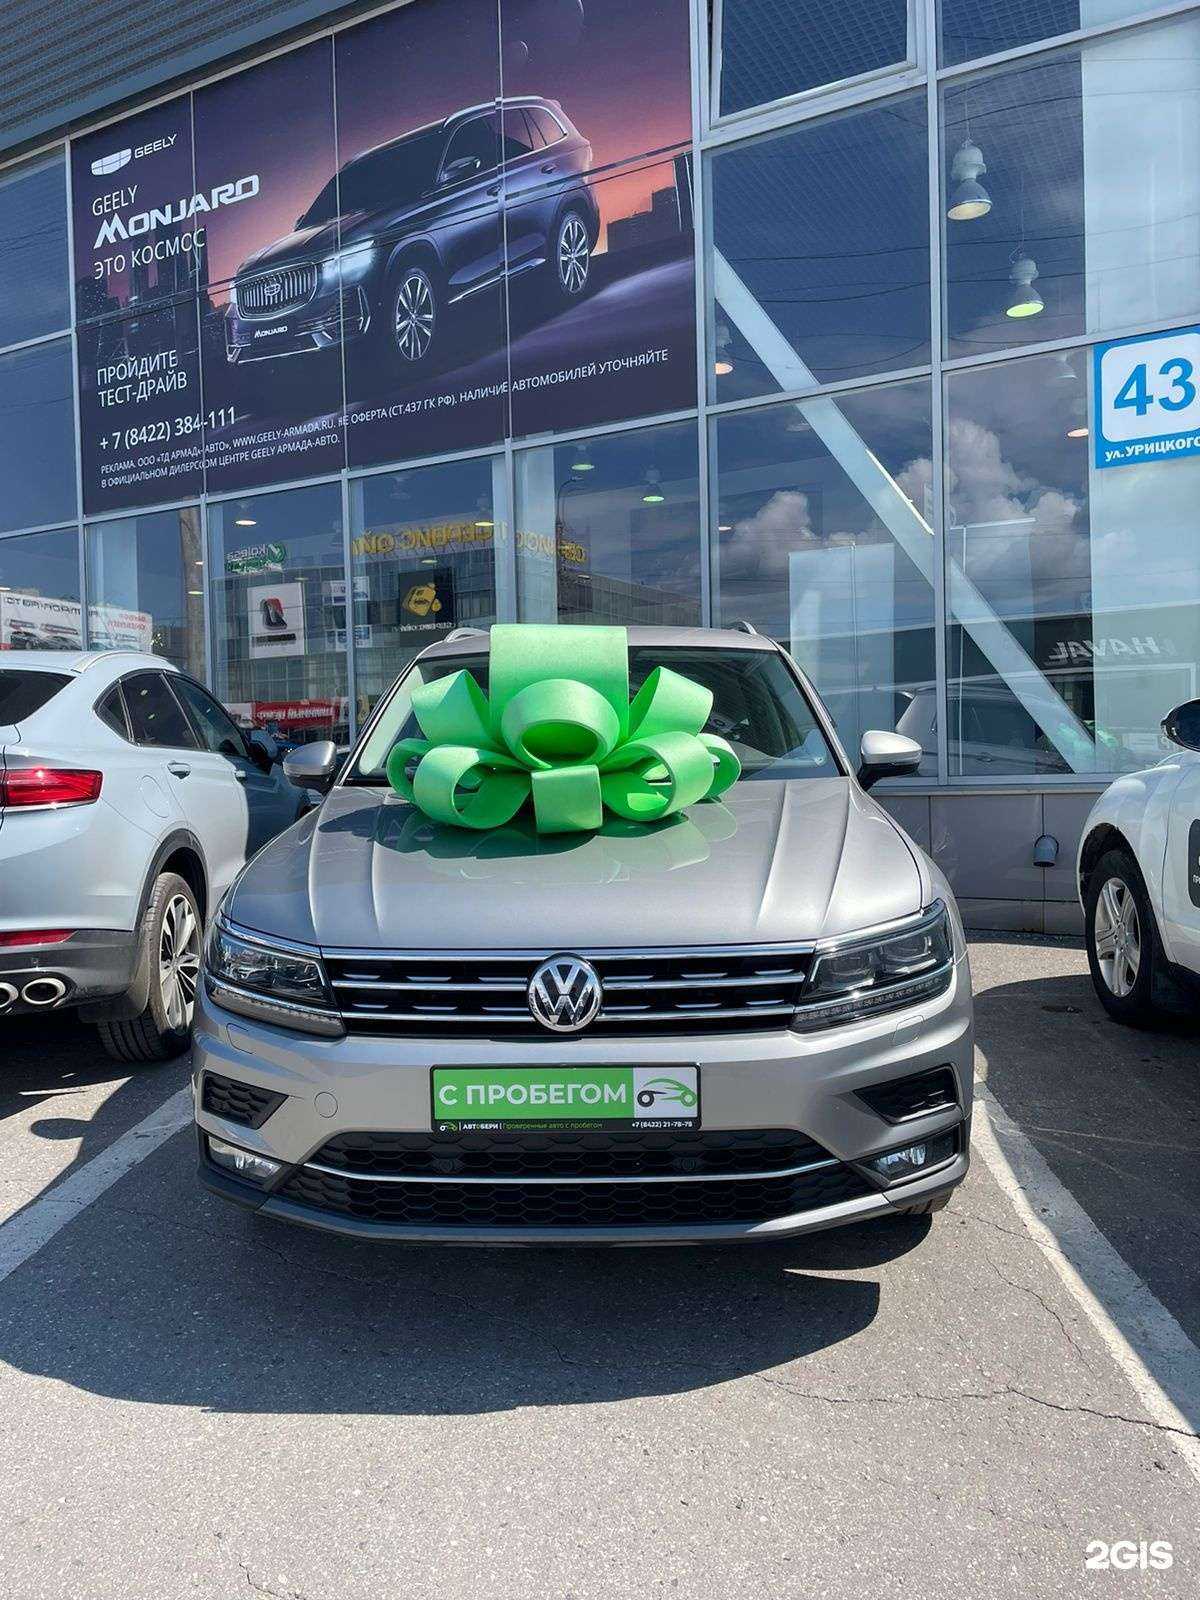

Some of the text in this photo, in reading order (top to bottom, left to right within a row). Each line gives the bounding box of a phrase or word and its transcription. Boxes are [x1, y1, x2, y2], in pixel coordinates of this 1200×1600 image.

[134, 134, 177, 159] GEELY
[92, 185, 138, 216] GEELY
[93, 174, 260, 249] MONJARO
[94, 228, 206, 280] ЭТО КОСМОС
[97, 350, 178, 386] ПРОЙДИТЕ
[1114, 357, 1197, 417] 43
[98, 371, 188, 408] ТЕСТ-ДРАЙВ
[138, 455, 155, 467] ООО
[351, 407, 388, 424] ОФЕРТА
[424, 398, 436, 410] ГК
[460, 381, 509, 402] НАЛИЧИЕ
[511, 362, 597, 391] АВТОМОБИЛЕЙ
[599, 348, 669, 374] УТОЧНЯЙТЕ
[125, 421, 171, 450] (8422)
[174, 406, 236, 437] 384-111
[108, 467, 168, 486] ОФИЦИАЛЬНОМ
[218, 450, 249, 467] ЦЕНТРЕ
[251, 446, 276, 460] GEELY
[438, 1083, 627, 1106] С ПРОБЕГОМ
